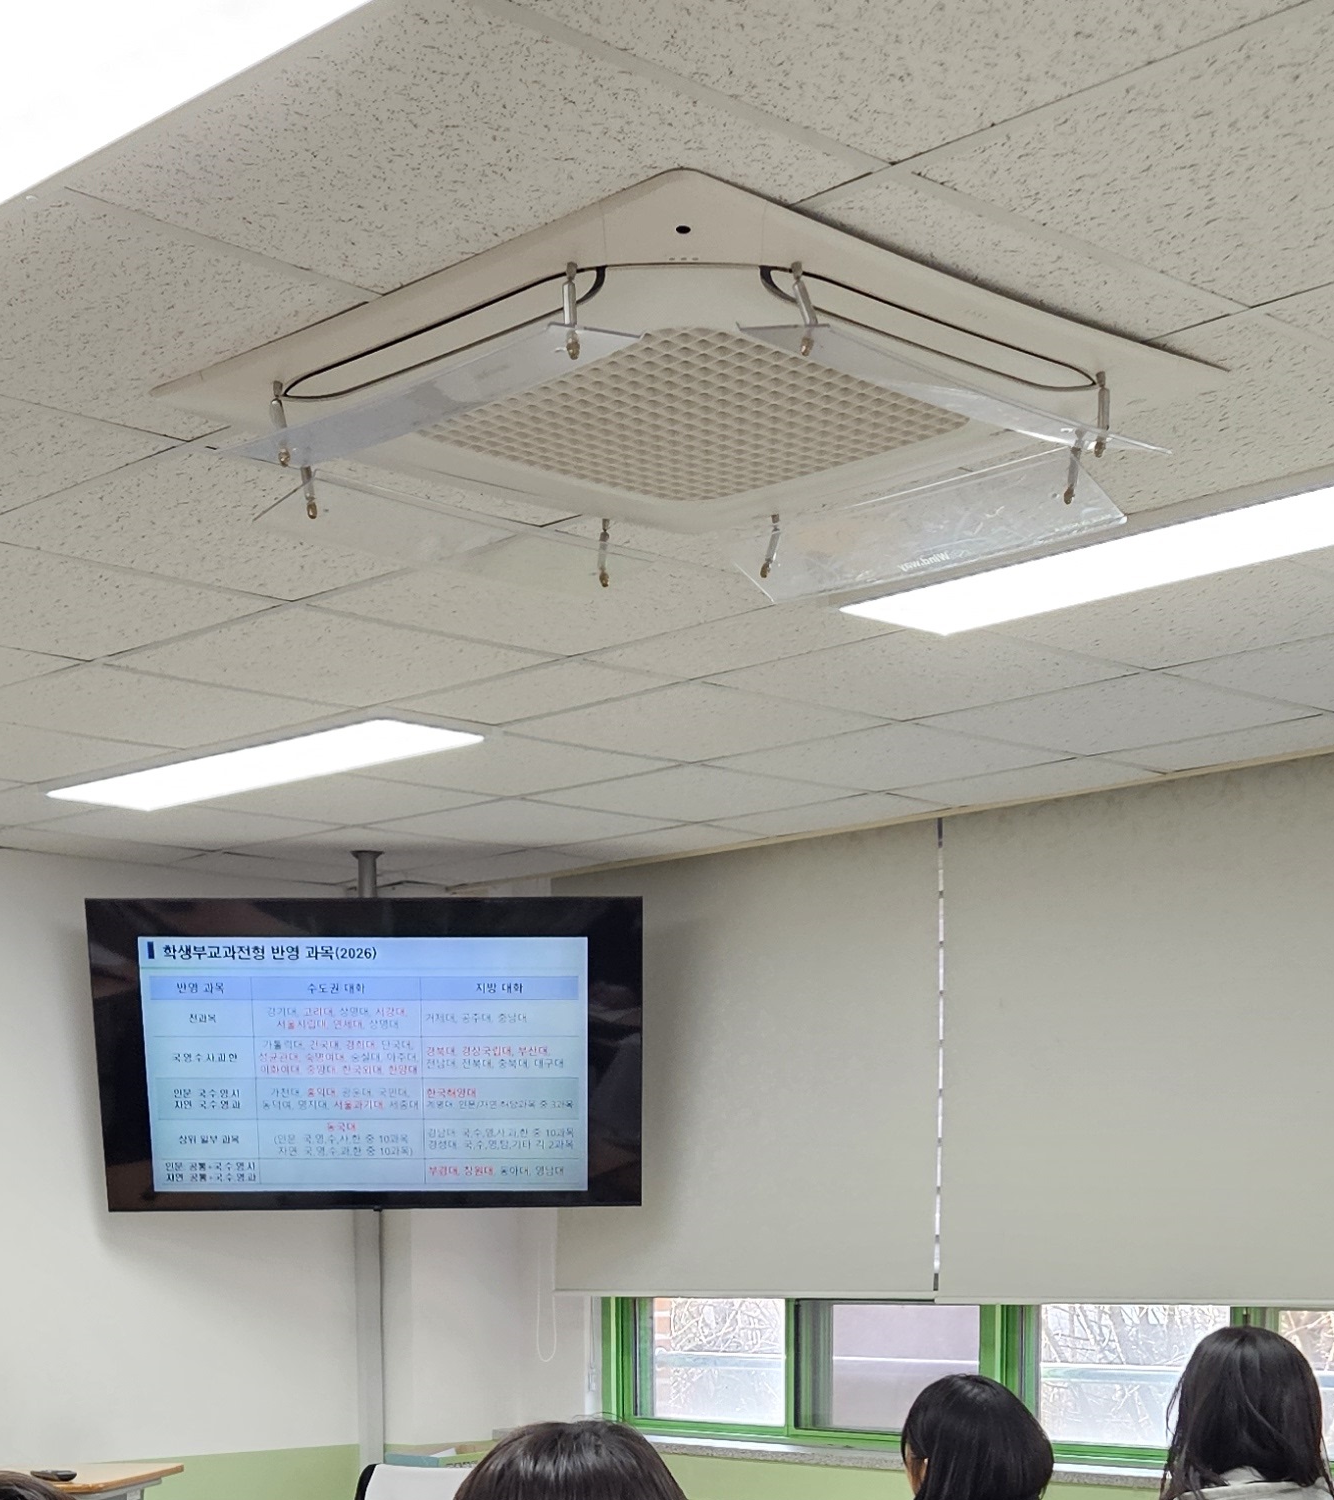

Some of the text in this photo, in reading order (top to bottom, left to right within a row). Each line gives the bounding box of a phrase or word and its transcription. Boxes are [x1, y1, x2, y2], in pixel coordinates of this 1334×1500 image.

[163, 945, 377, 961] 학생부교과전형 반영 과목(2026)
[176, 982, 225, 994] 반영 과목
[476, 982, 497, 994] 지방
